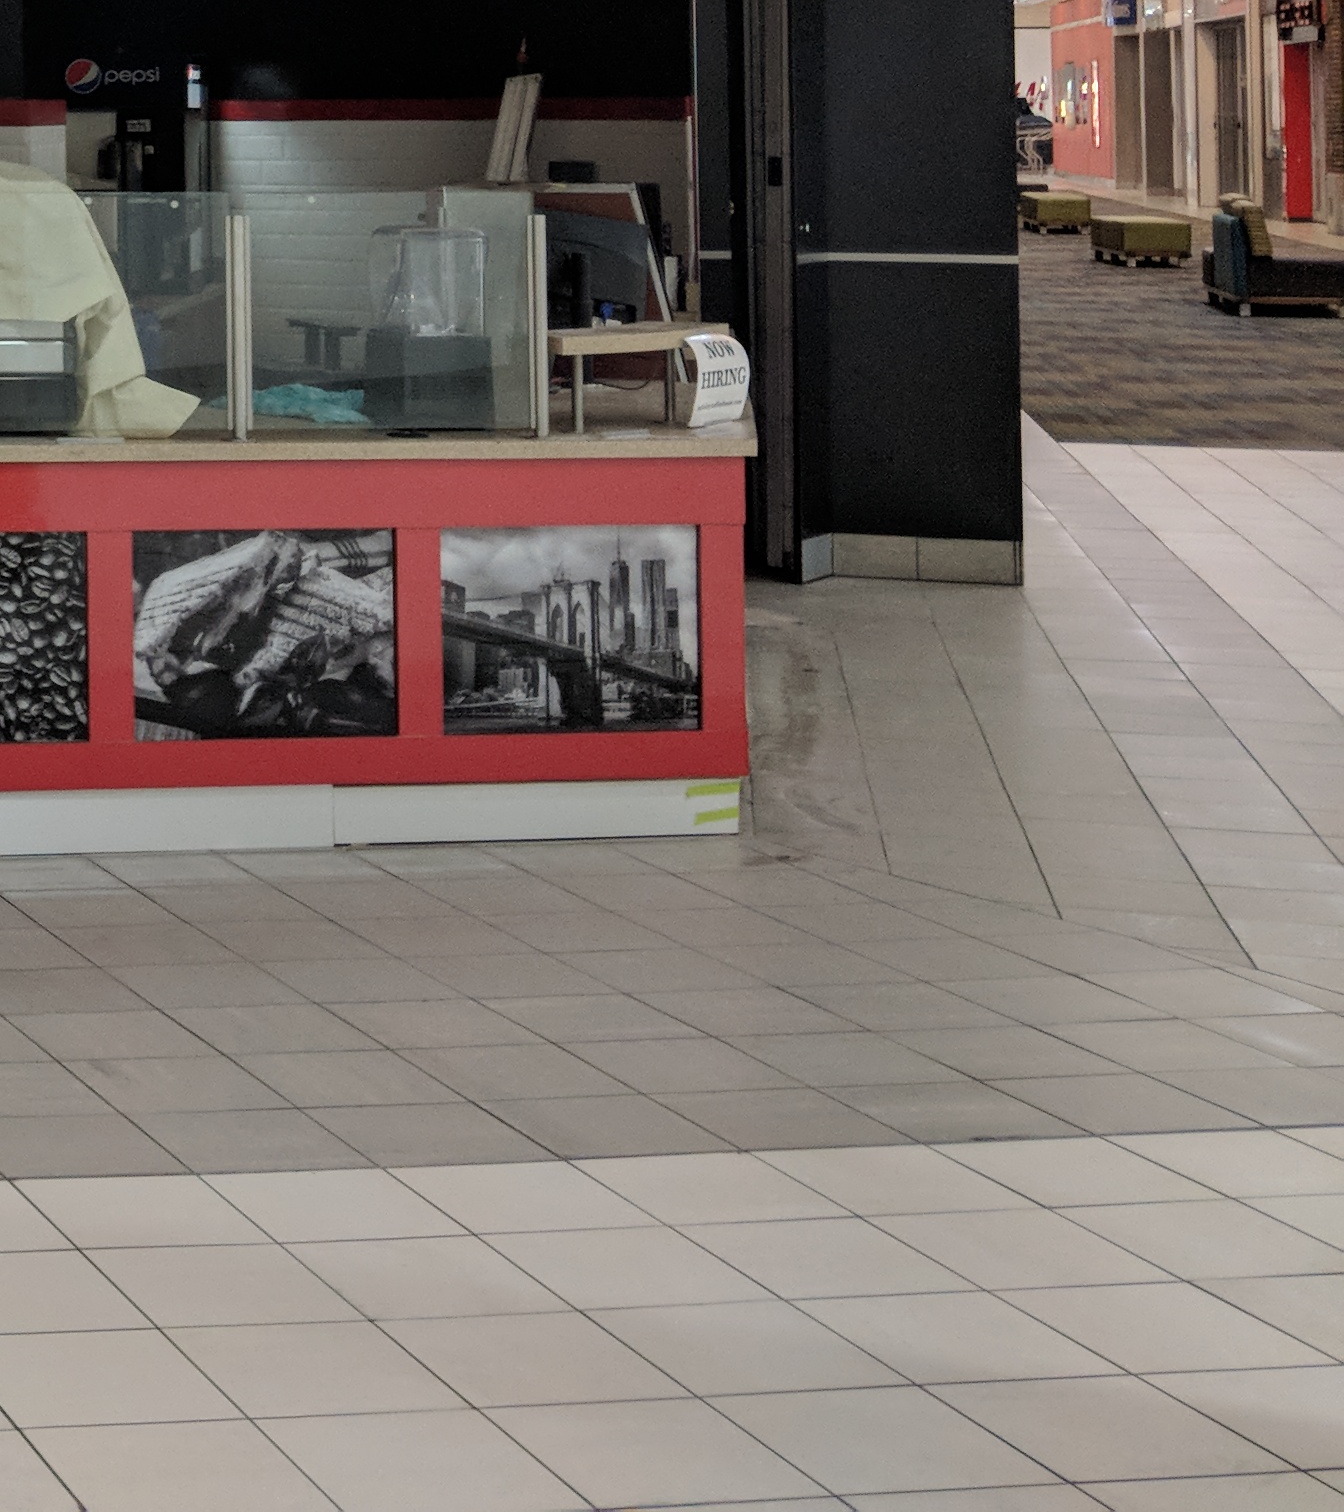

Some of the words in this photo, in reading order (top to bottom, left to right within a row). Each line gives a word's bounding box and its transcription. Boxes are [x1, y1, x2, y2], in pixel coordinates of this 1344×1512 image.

[104, 67, 160, 85] pepsi
[703, 340, 736, 359] NOW
[701, 366, 746, 389] HIRING
